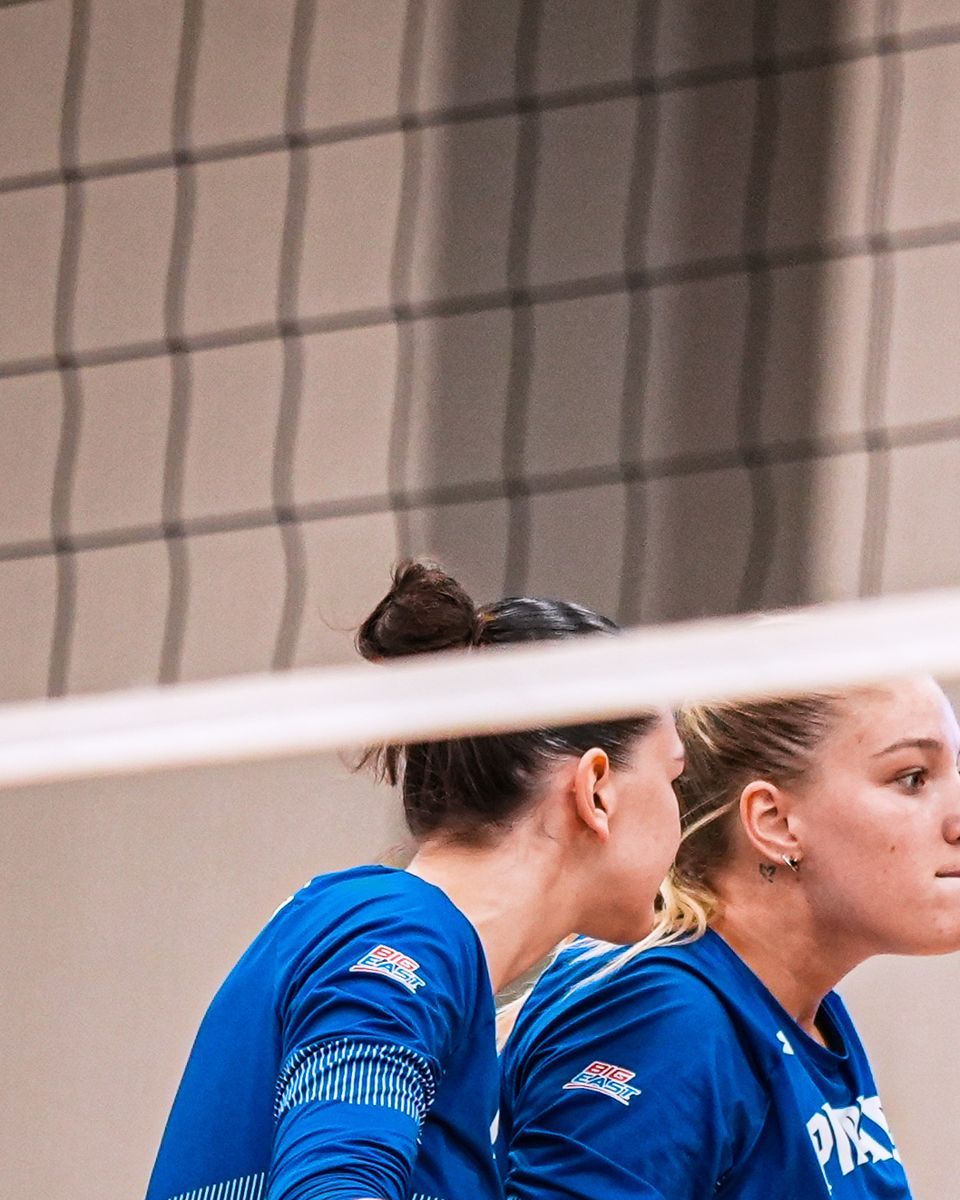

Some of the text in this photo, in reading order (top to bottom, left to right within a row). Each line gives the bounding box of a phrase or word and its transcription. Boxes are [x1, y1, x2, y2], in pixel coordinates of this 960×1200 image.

[360, 956, 422, 986] EAST
[371, 946, 418, 972] BIG
[585, 1063, 633, 1082] BIG
[573, 1073, 640, 1098] EAST
